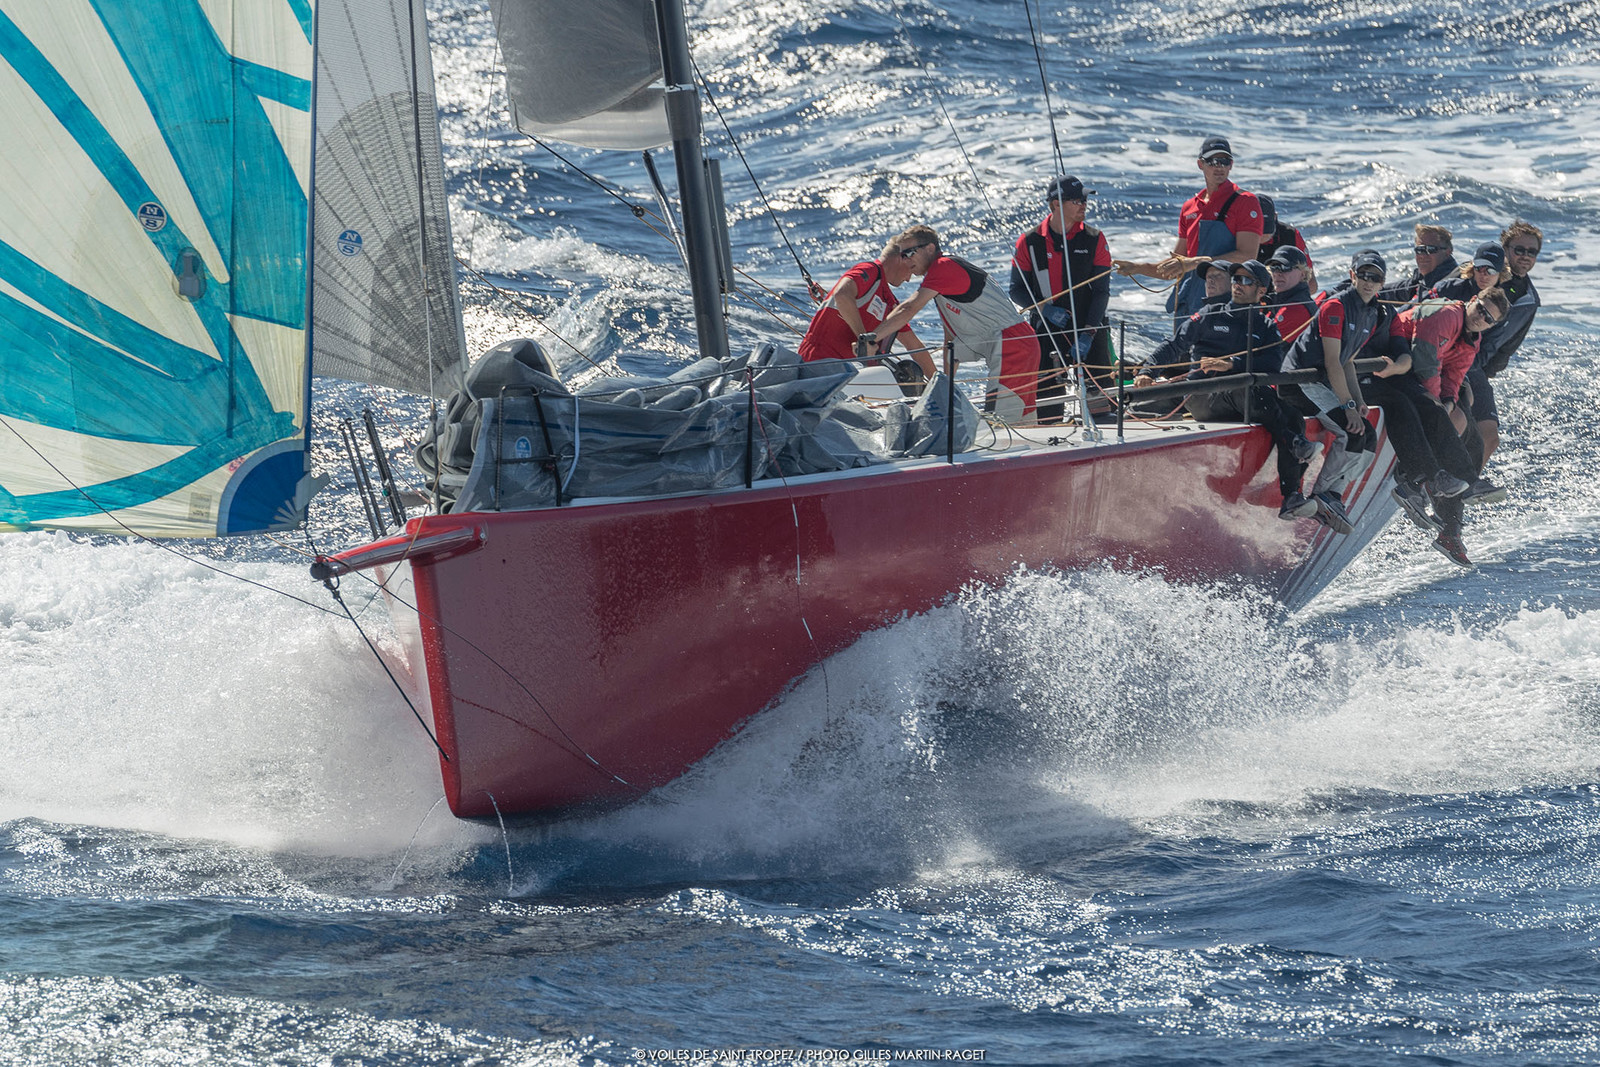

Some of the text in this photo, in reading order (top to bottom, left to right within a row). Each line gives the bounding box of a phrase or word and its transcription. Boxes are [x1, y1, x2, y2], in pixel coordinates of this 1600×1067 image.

[145, 206, 159, 215] N
[145, 219, 158, 227] S
[344, 232, 358, 242] N
[342, 245, 355, 254] S
